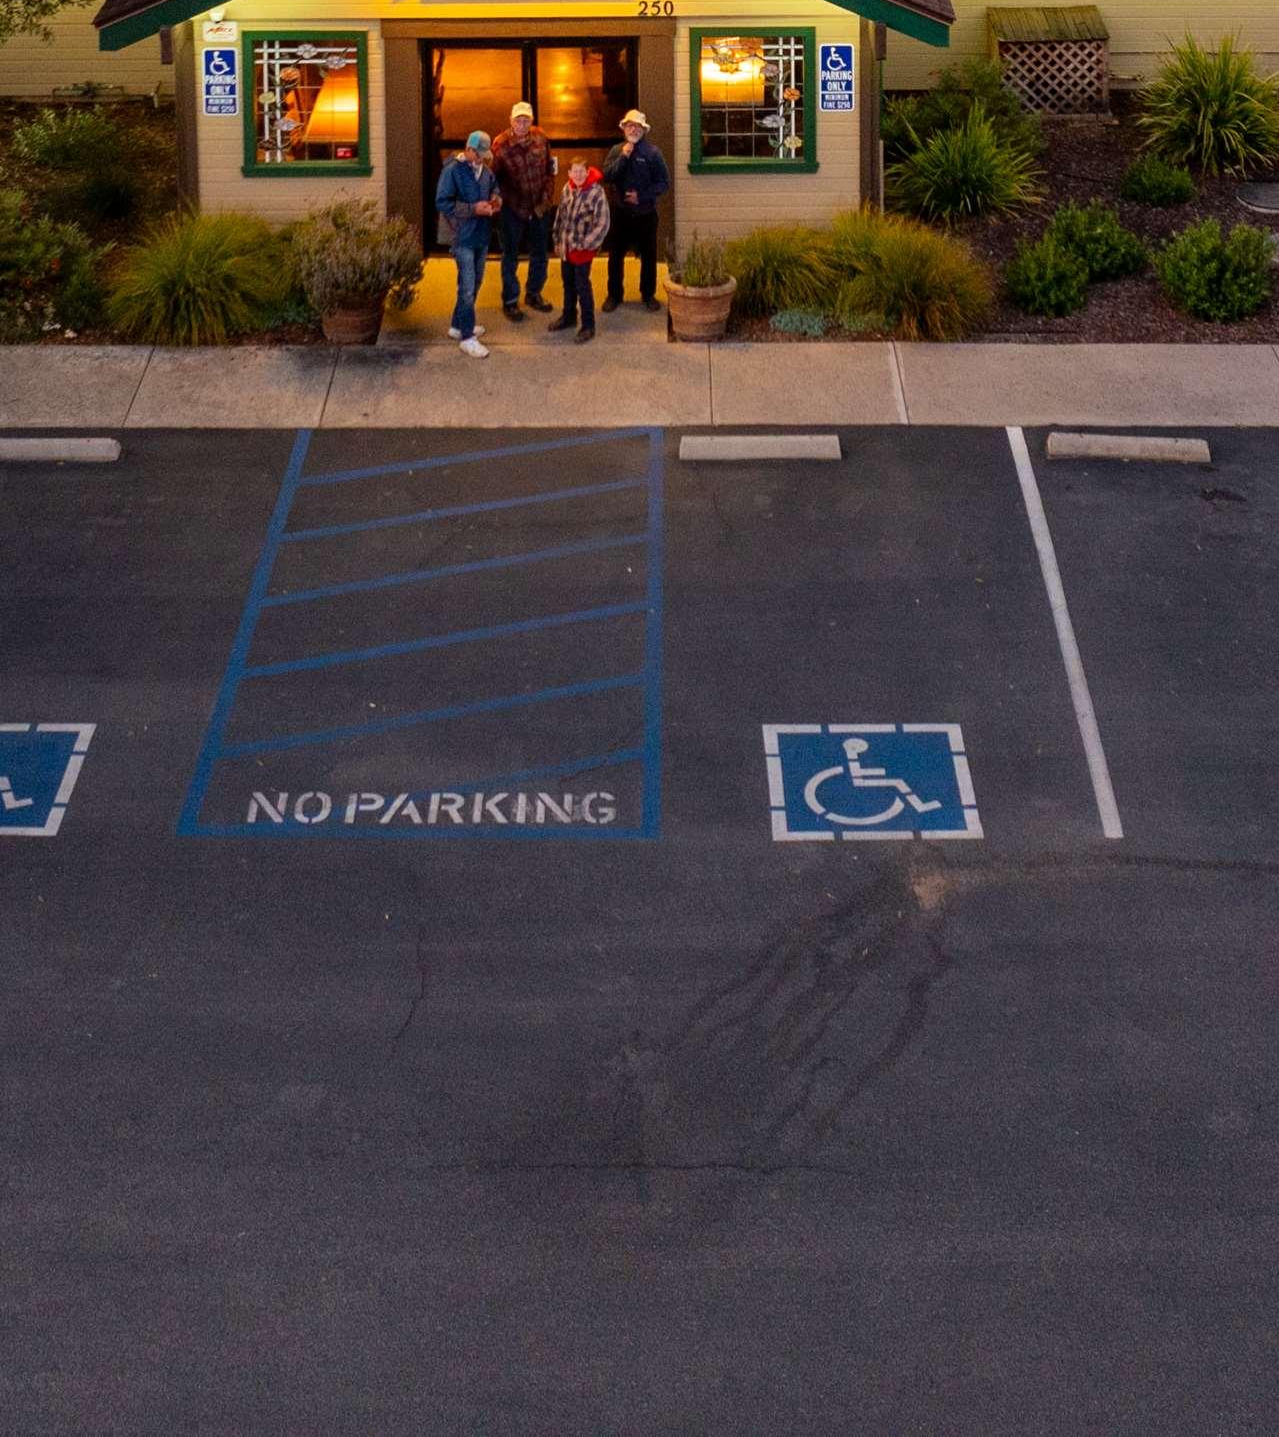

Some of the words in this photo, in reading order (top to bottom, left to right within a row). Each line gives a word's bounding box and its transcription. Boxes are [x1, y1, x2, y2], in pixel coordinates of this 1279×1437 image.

[637, 0, 675, 16] 250
[821, 70, 853, 81] PARKING
[827, 81, 846, 91] ONLY
[823, 101, 836, 109] FINE
[837, 101, 851, 109] $250
[247, 791, 332, 824] NO
[344, 791, 618, 824] PARKING
